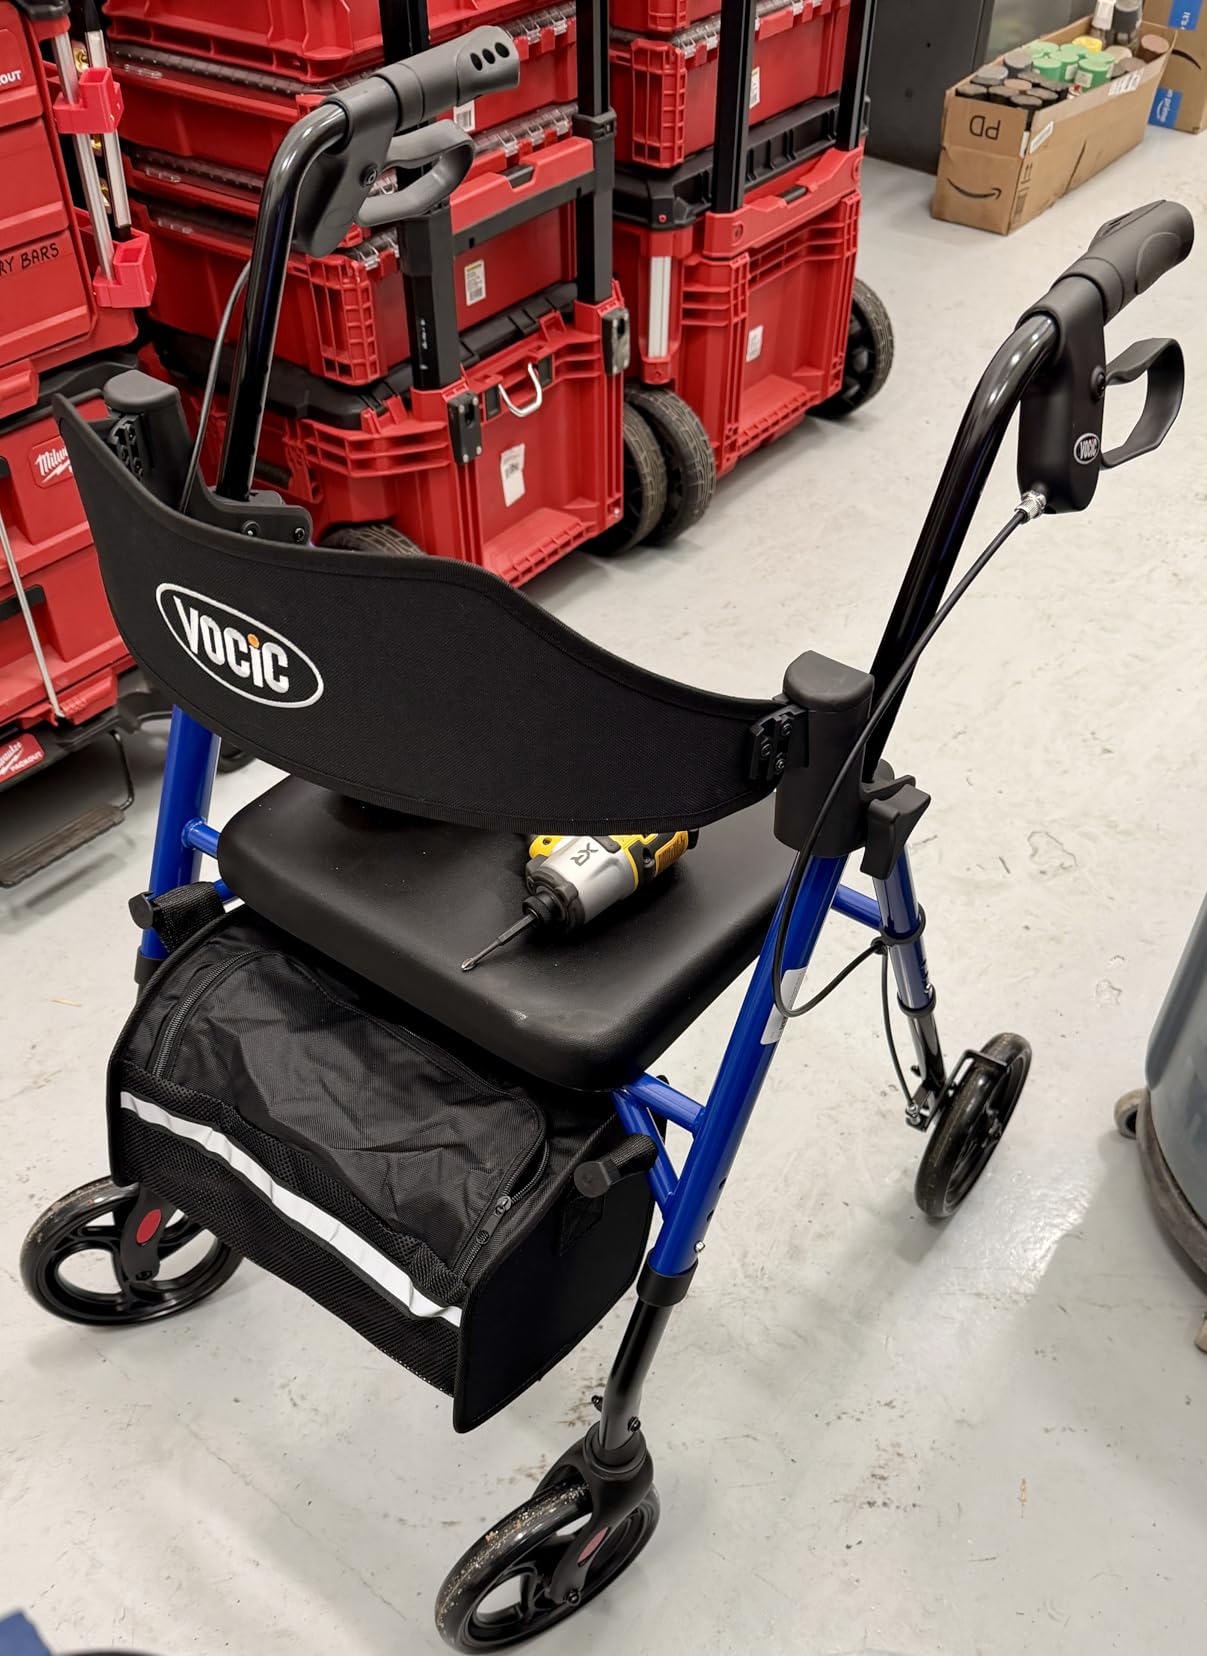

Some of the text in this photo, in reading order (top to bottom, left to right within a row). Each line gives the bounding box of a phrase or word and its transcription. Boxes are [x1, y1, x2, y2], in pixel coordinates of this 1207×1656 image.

[0, 70, 21, 85] OUT
[969, 115, 1002, 140] PD
[21, 242, 59, 270] BARS
[569, 842, 599, 867] XR
